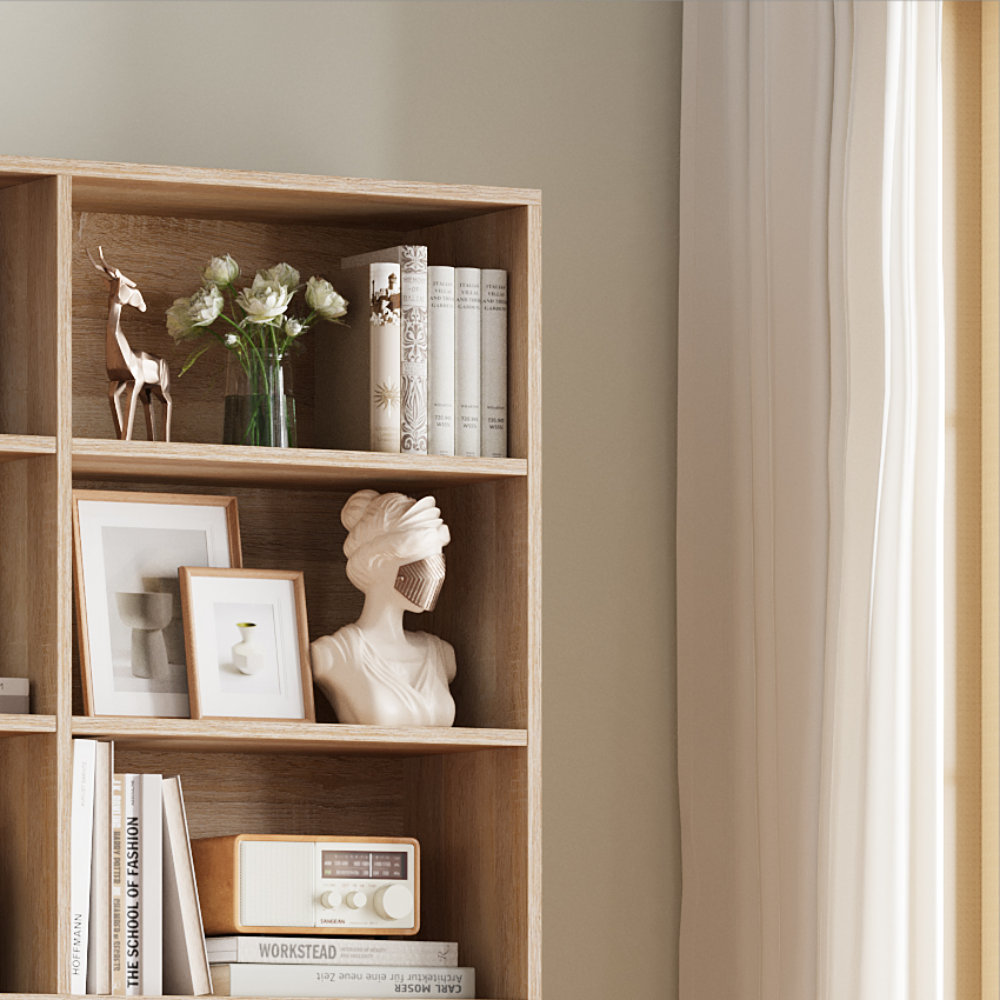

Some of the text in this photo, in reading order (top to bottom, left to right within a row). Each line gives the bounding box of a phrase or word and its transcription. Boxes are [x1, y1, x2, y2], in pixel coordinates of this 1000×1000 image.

[126, 816, 139, 988] THE SCHOOL OF FASHION
[72, 913, 83, 976] HOFFMANN
[258, 942, 337, 960] WORKSTEAD
[316, 971, 463, 984] Architektur für eine neue Zeit
[394, 982, 462, 994] CARL MOSER
